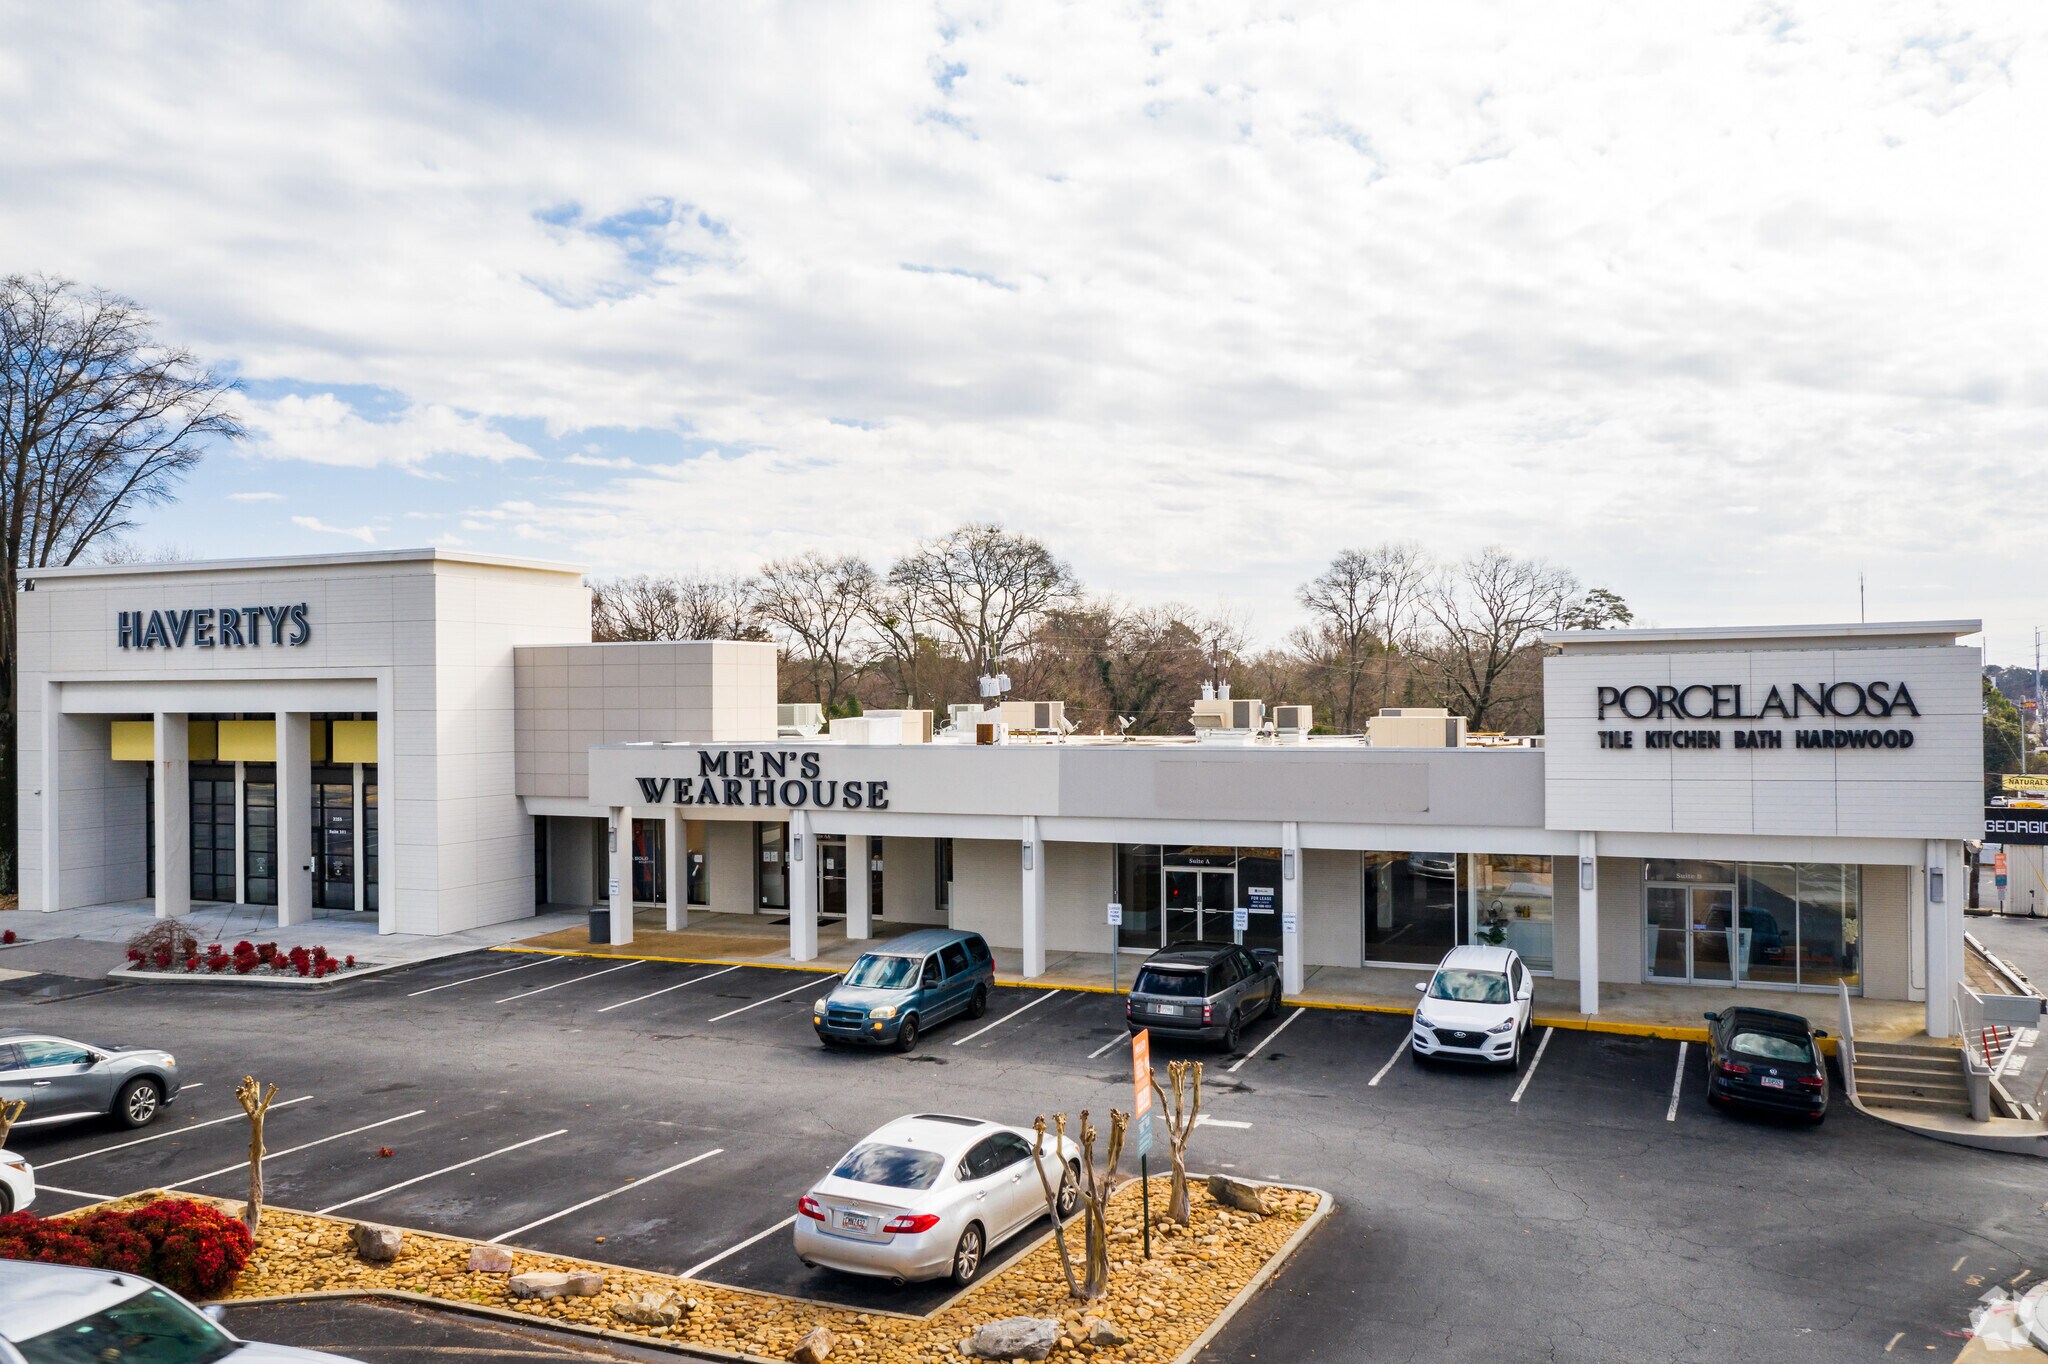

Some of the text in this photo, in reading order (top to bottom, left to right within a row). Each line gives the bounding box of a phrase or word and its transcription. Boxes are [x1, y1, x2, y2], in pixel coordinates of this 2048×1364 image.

[117, 602, 311, 648] HAVERTYS
[1597, 681, 1921, 720] PORCELANOSA
[1597, 729, 1914, 749] TILE KITCHEN BATH HARDWOOD
[697, 750, 820, 779] MEN'S
[635, 777, 889, 809] WEARHOUSE
[2008, 778, 2043, 786] NATURAL
